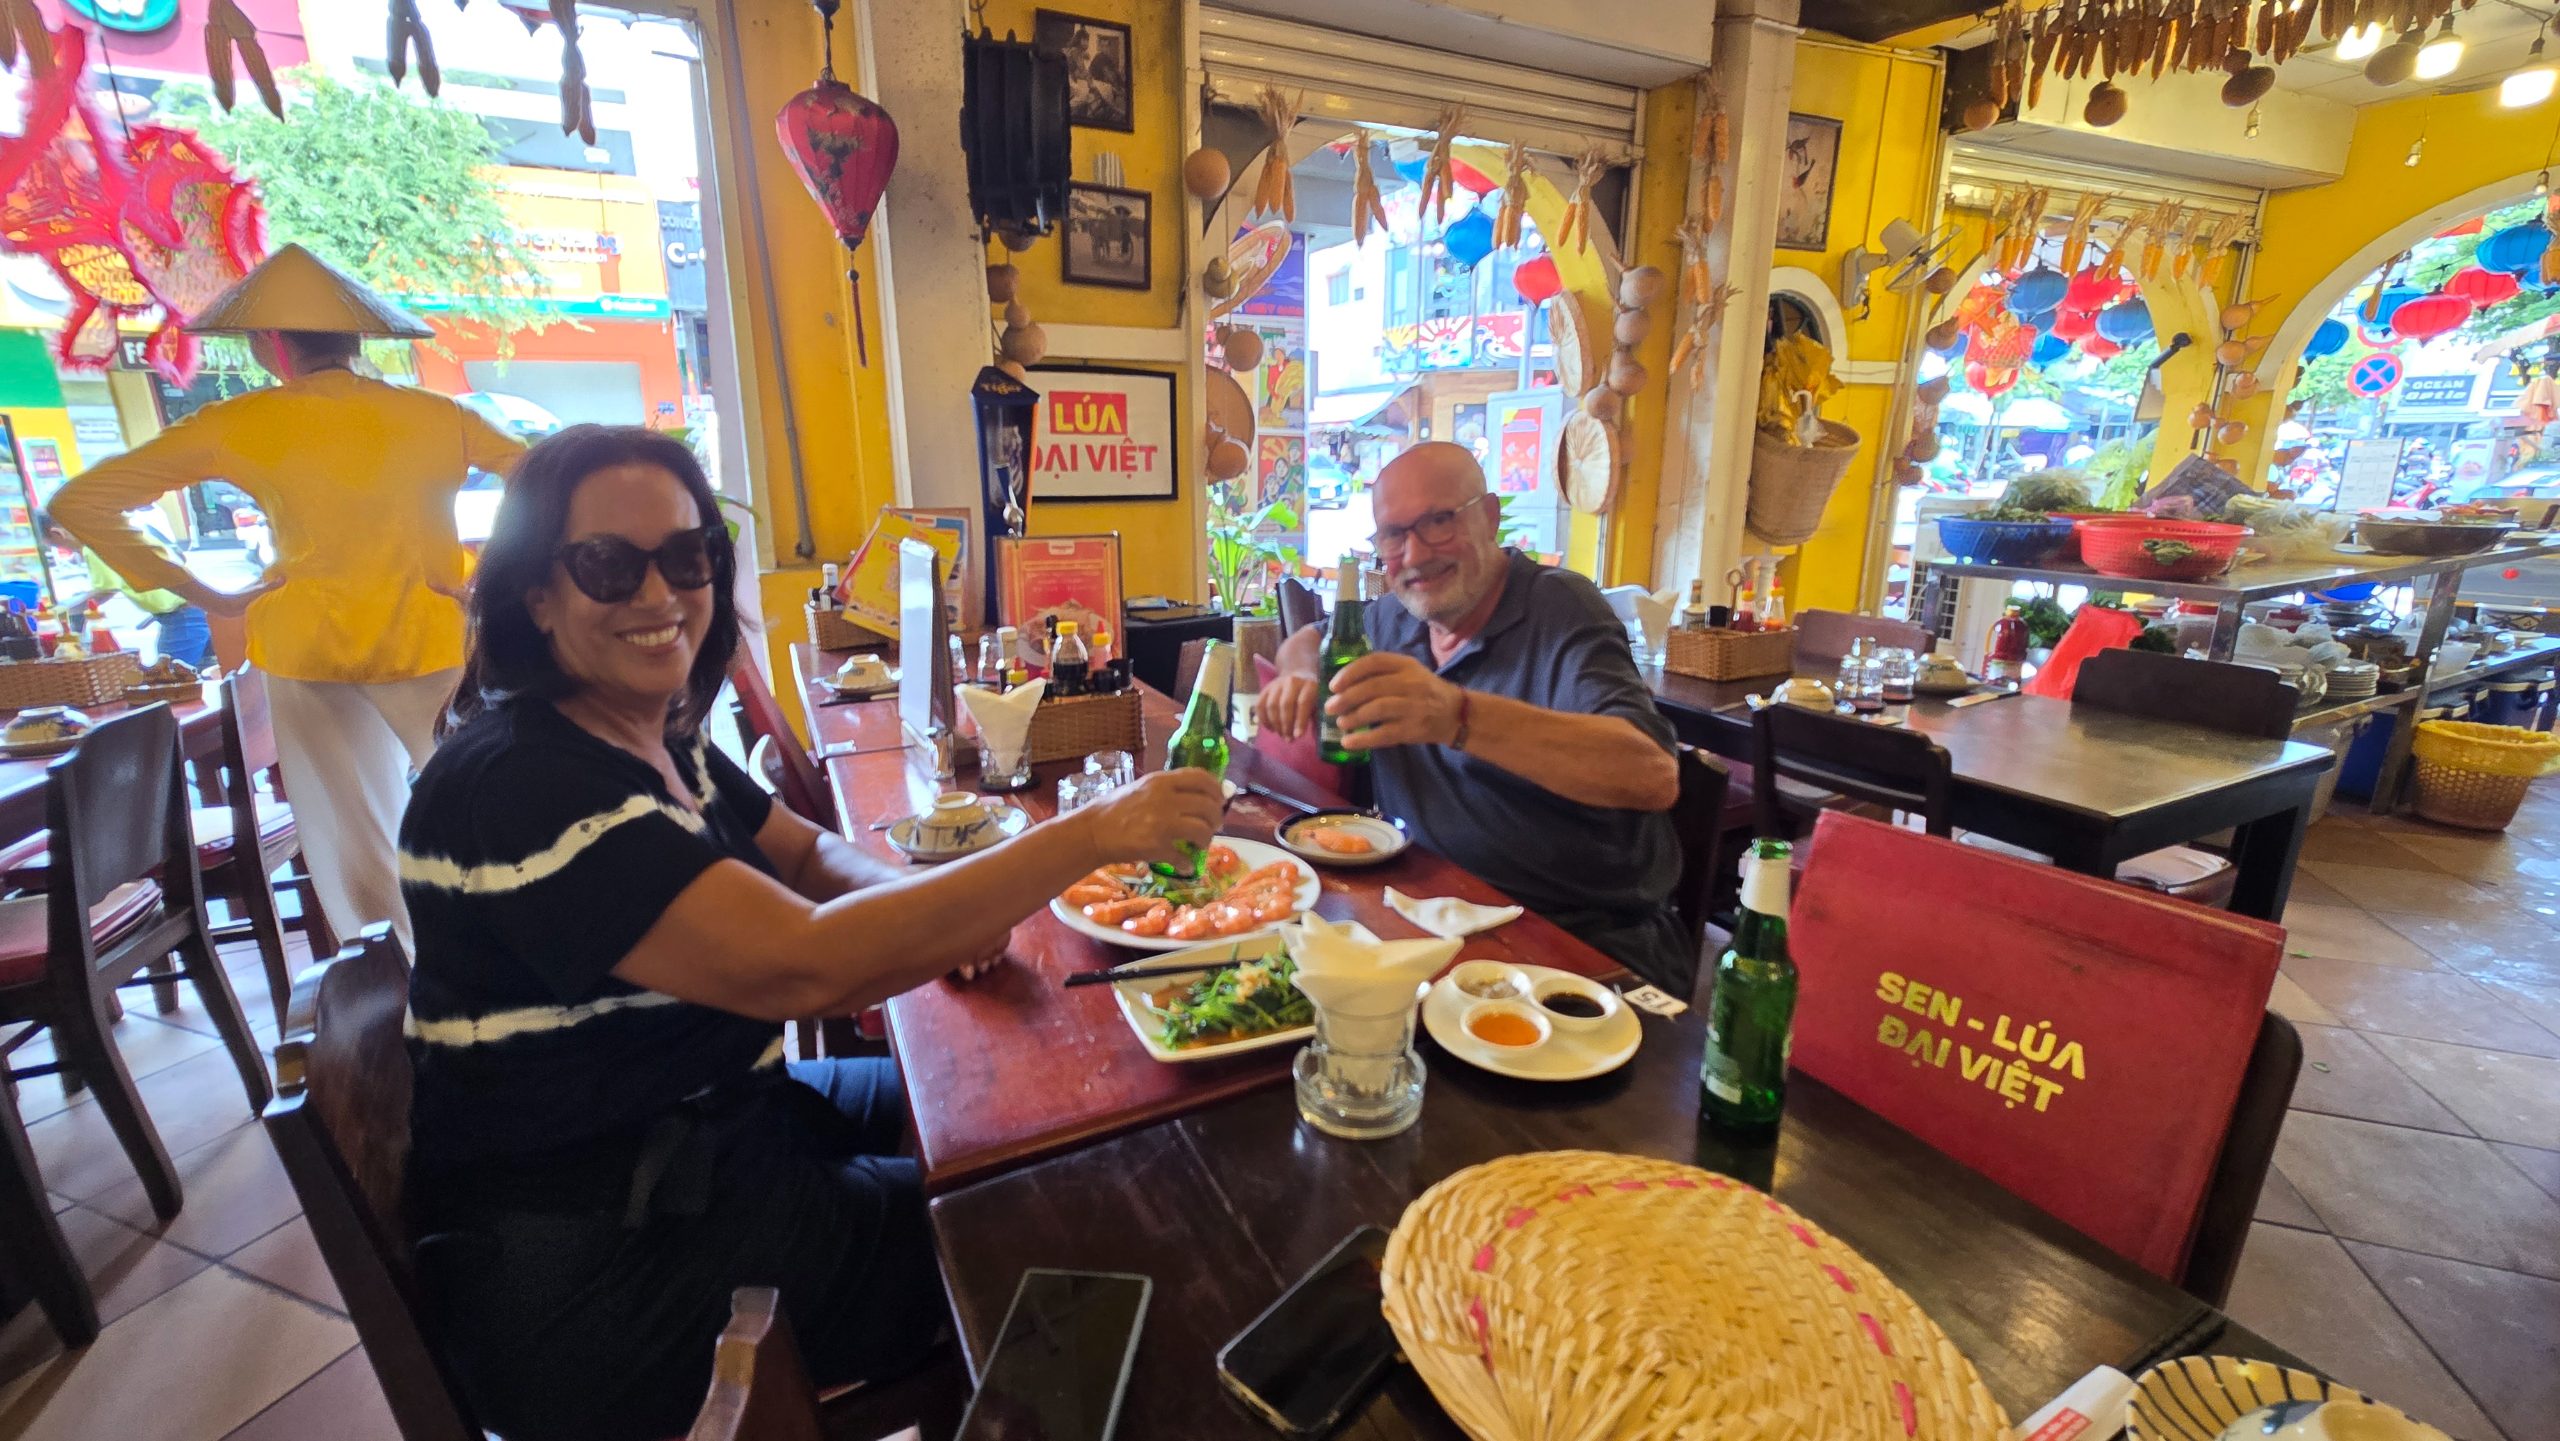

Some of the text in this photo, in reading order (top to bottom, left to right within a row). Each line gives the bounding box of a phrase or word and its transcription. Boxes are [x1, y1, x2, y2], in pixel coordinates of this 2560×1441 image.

[2412, 380, 2465, 390] OCEAN
[1055, 394, 1122, 433] LÚA
[1085, 437, 1158, 480] VIỆT
[1876, 971, 1963, 1027] SEN
[1992, 1014, 2086, 1080] LÚA
[1877, 1014, 2065, 1113] ĐẠI VIỆT
